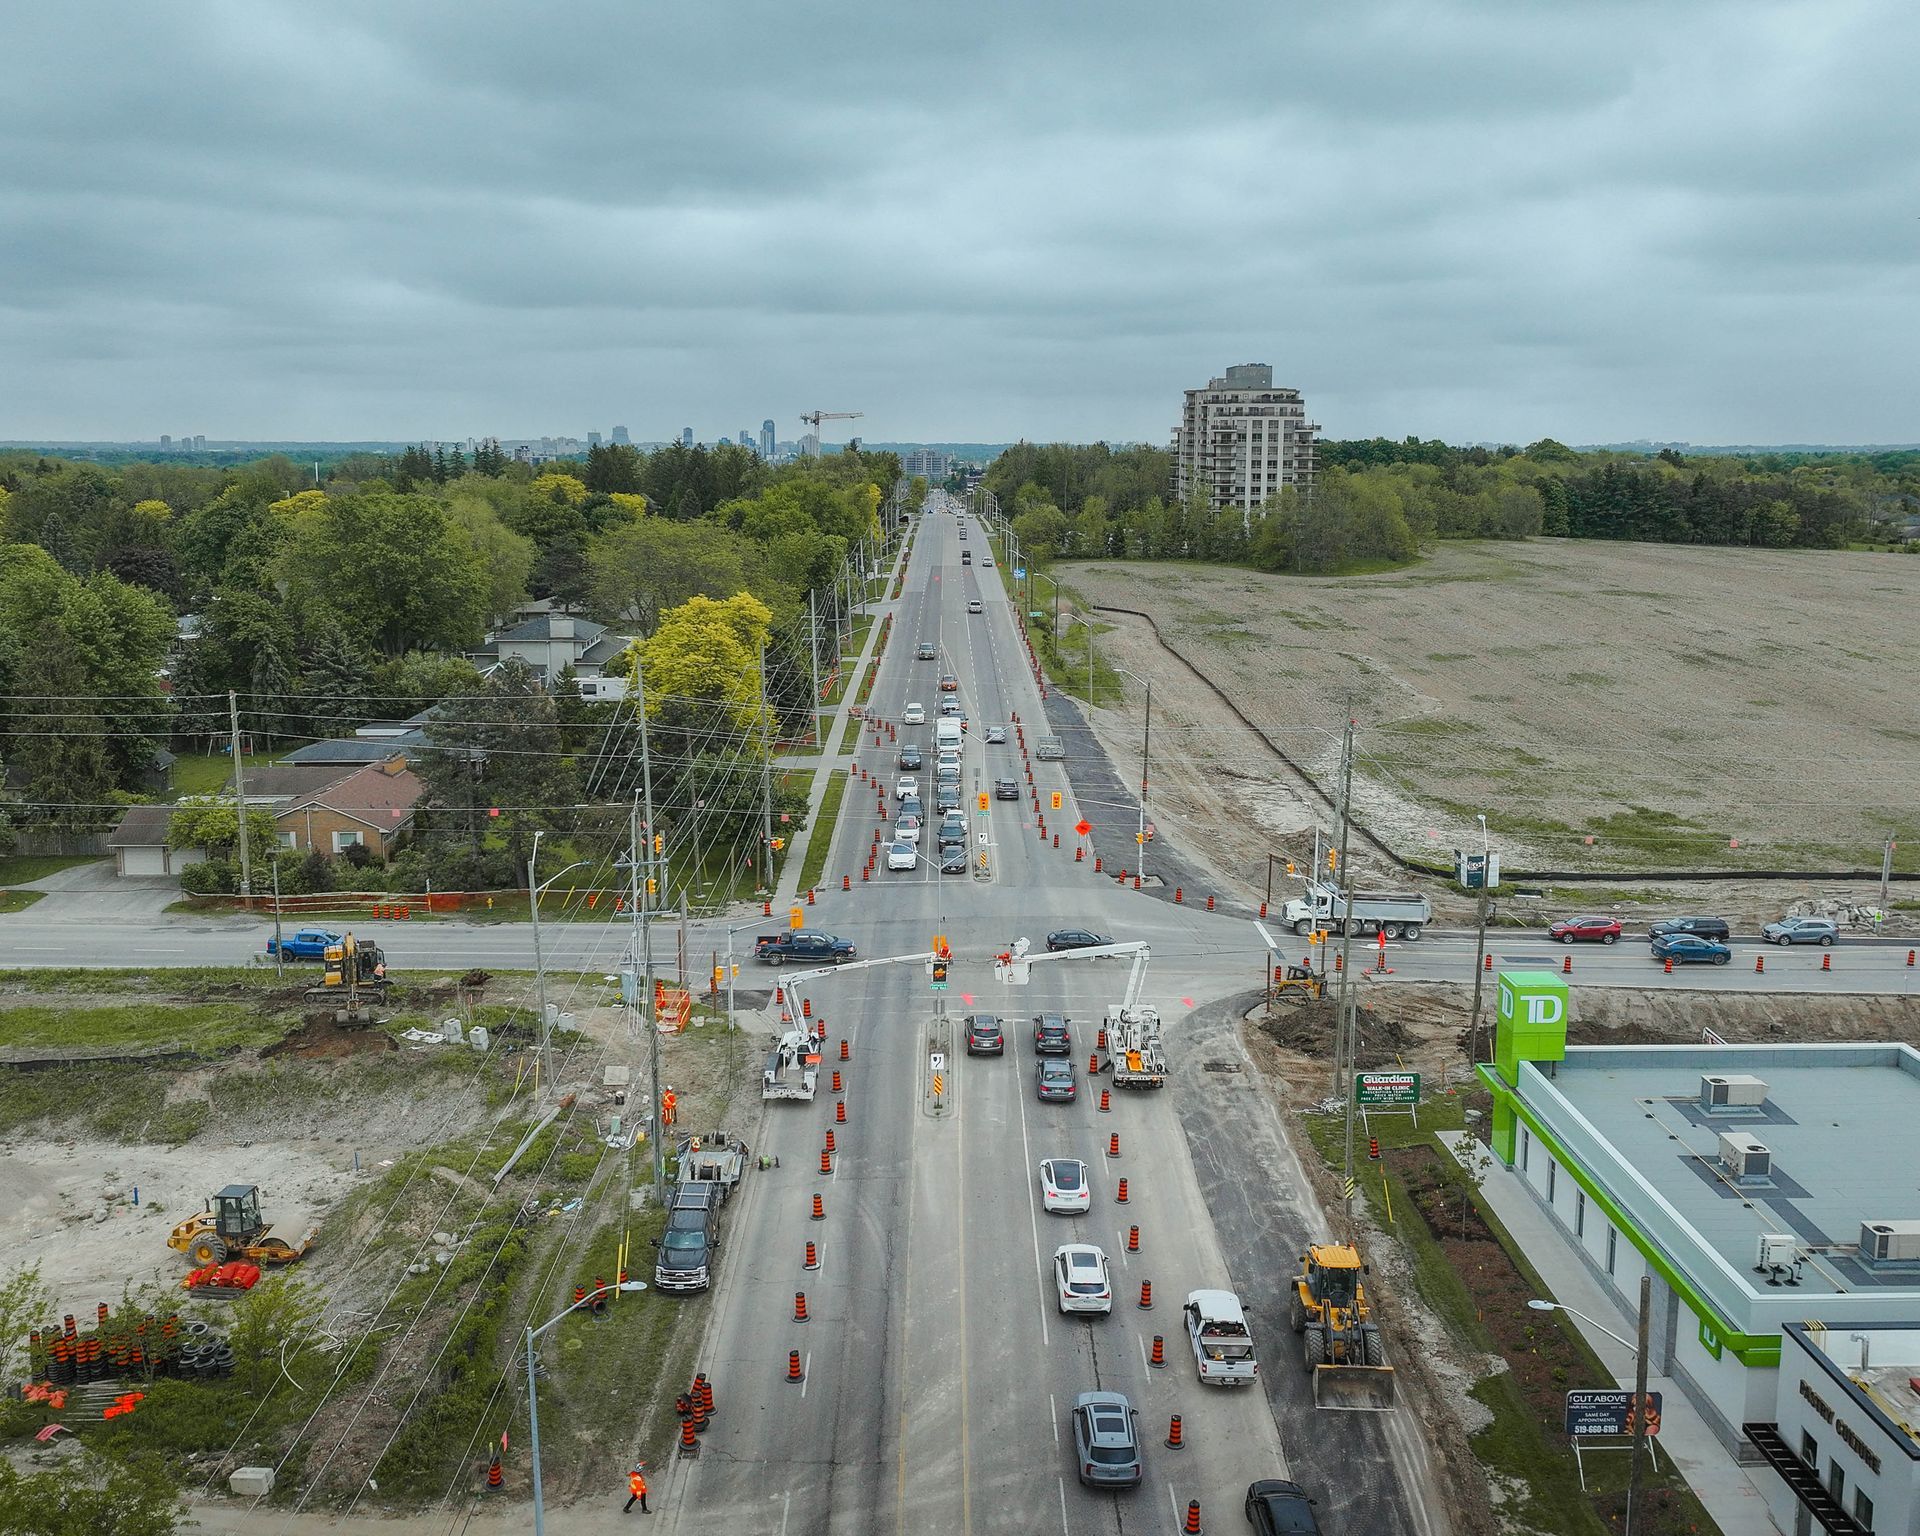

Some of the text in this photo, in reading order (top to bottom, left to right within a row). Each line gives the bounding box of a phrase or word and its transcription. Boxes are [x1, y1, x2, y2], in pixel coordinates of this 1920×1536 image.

[1500, 983, 1514, 1019] TD
[1520, 995, 1563, 1024] TD
[1362, 1075, 1414, 1084] Guardian
[1836, 1418, 1881, 1476] CULTURE
